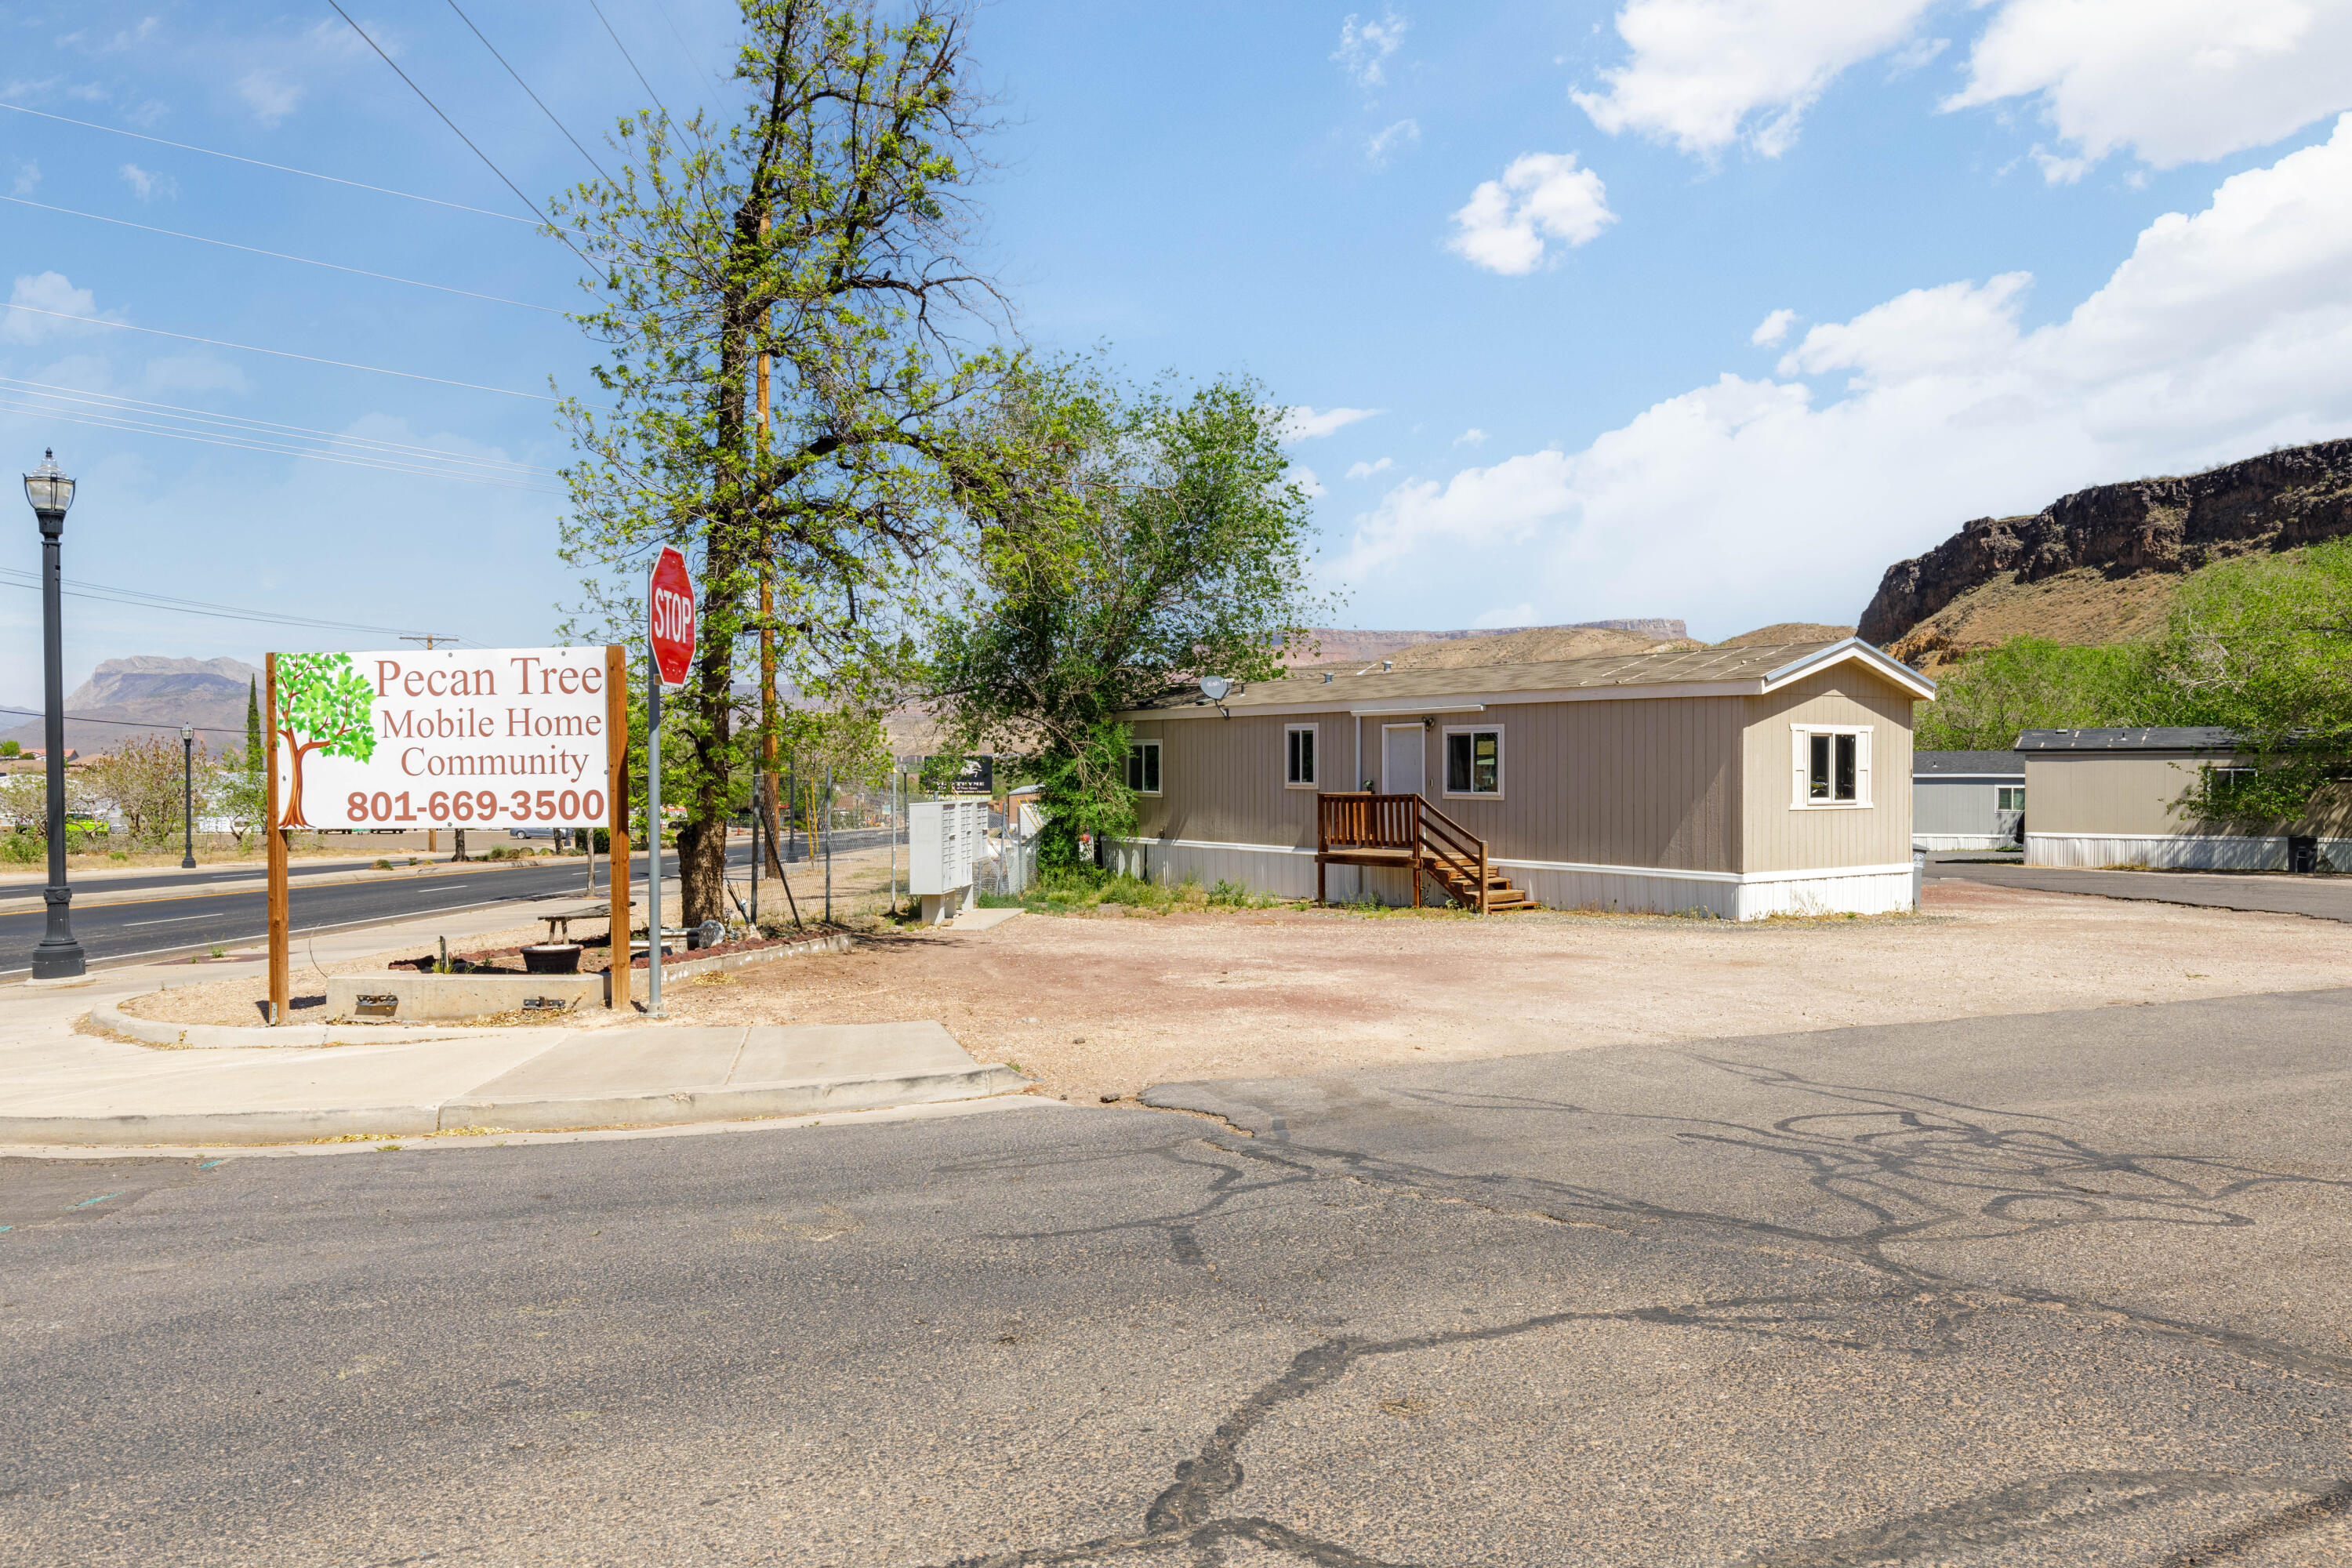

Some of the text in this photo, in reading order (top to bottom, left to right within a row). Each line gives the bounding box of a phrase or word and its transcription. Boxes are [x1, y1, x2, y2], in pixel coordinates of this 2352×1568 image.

[655, 587, 691, 644] STOP
[376, 657, 602, 697] Pecan Tree
[381, 707, 602, 739] Mobile Home
[401, 745, 589, 783] Community
[347, 789, 604, 822] 801-669-3500
